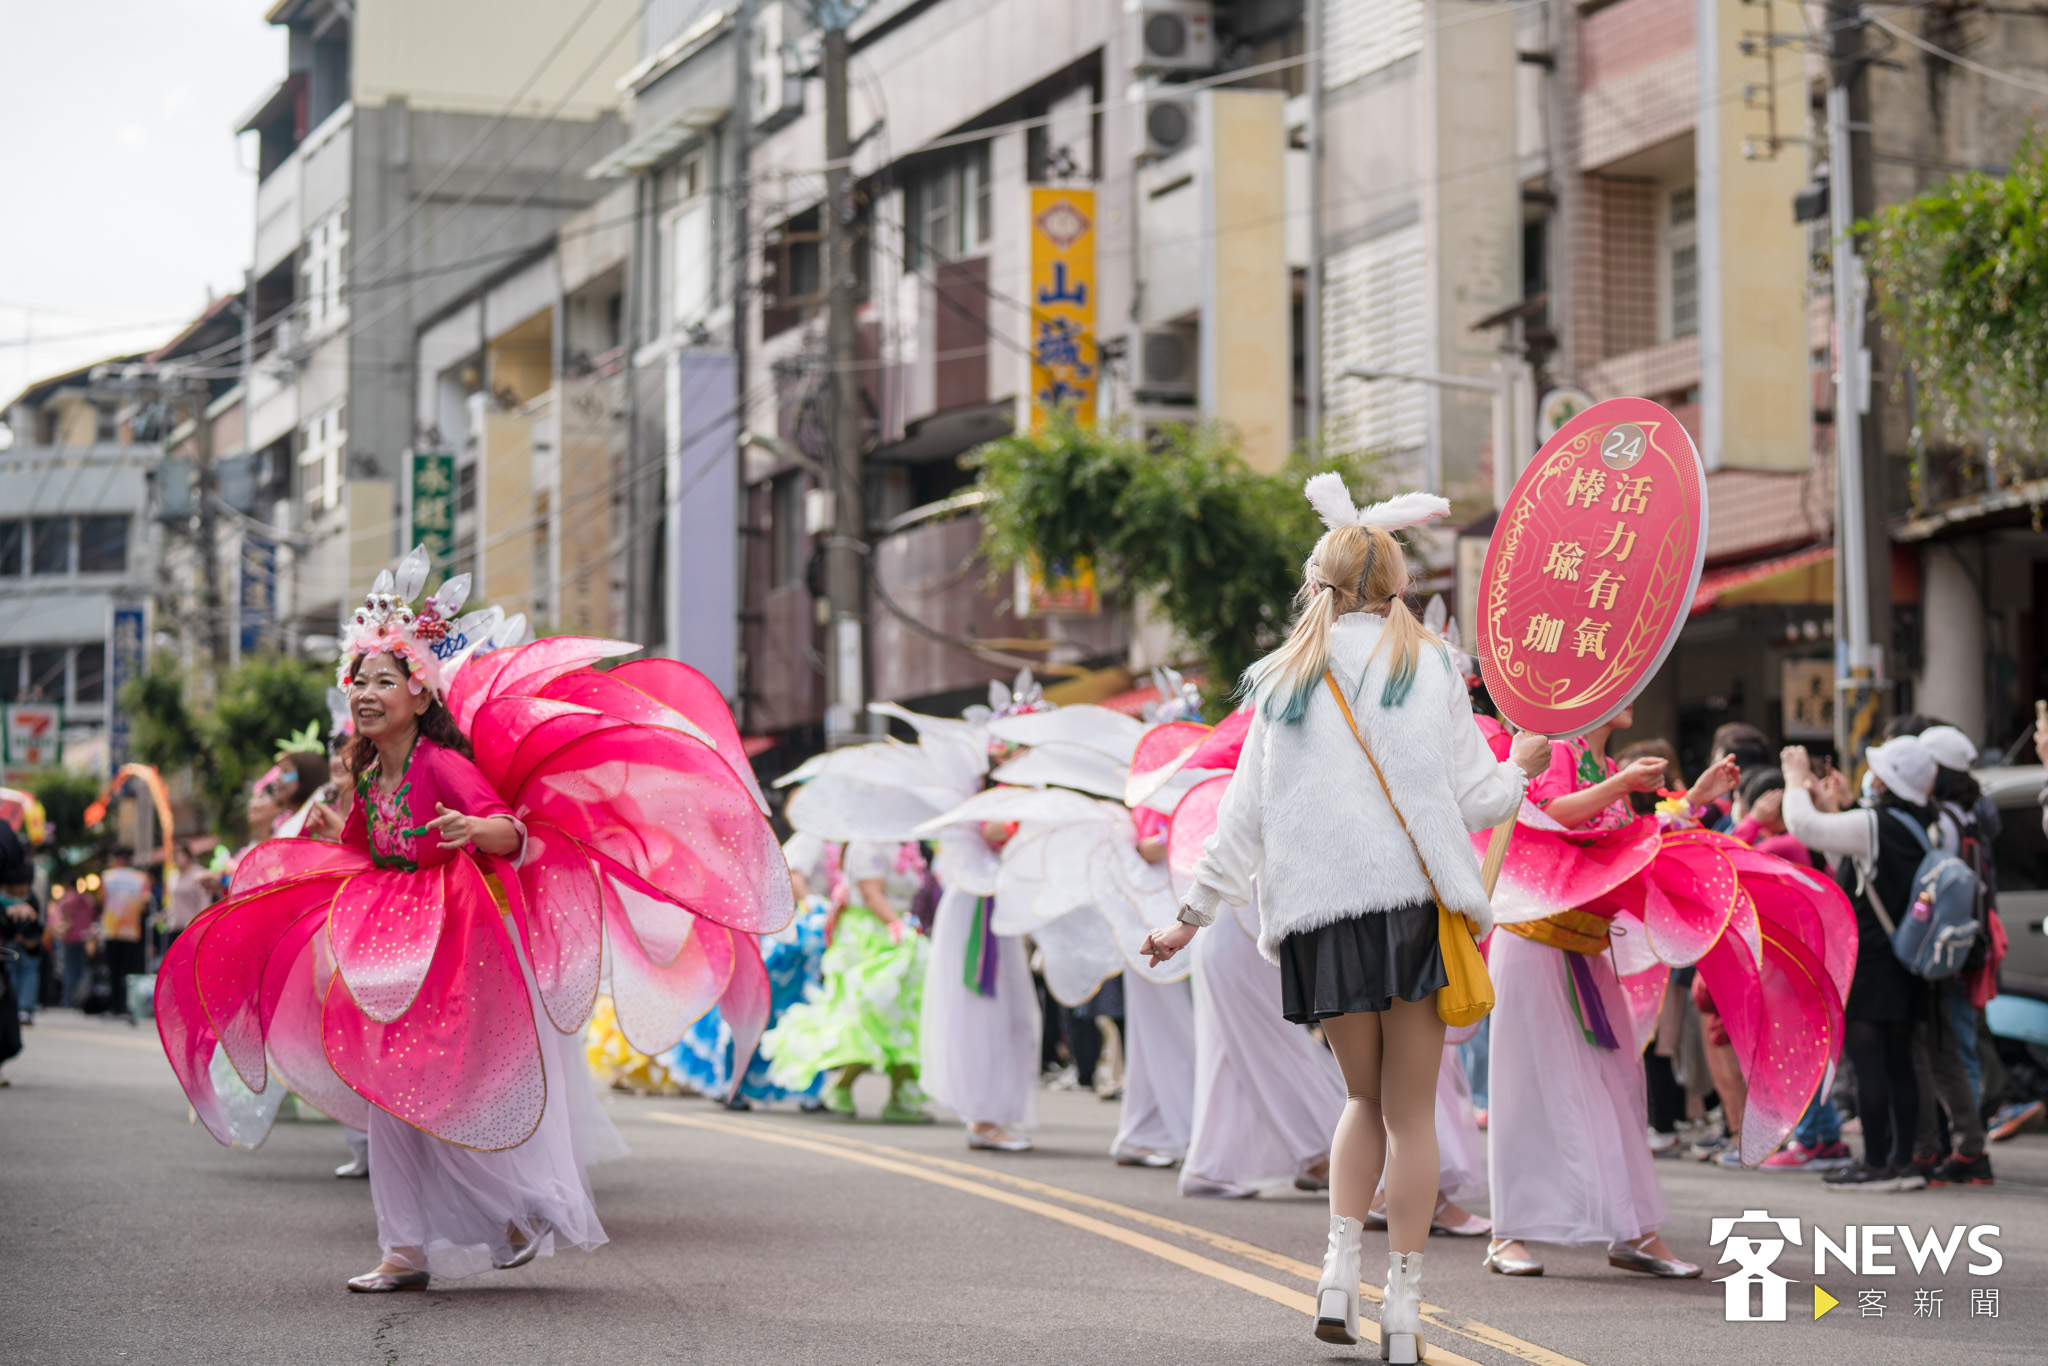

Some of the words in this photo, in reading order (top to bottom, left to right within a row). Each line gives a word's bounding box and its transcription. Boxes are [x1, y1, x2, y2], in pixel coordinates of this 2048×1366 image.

[1603, 431, 1642, 462] 24
[1521, 466, 1608, 653] 棒瑜珈
[1569, 472, 1653, 661] 活力有氧
